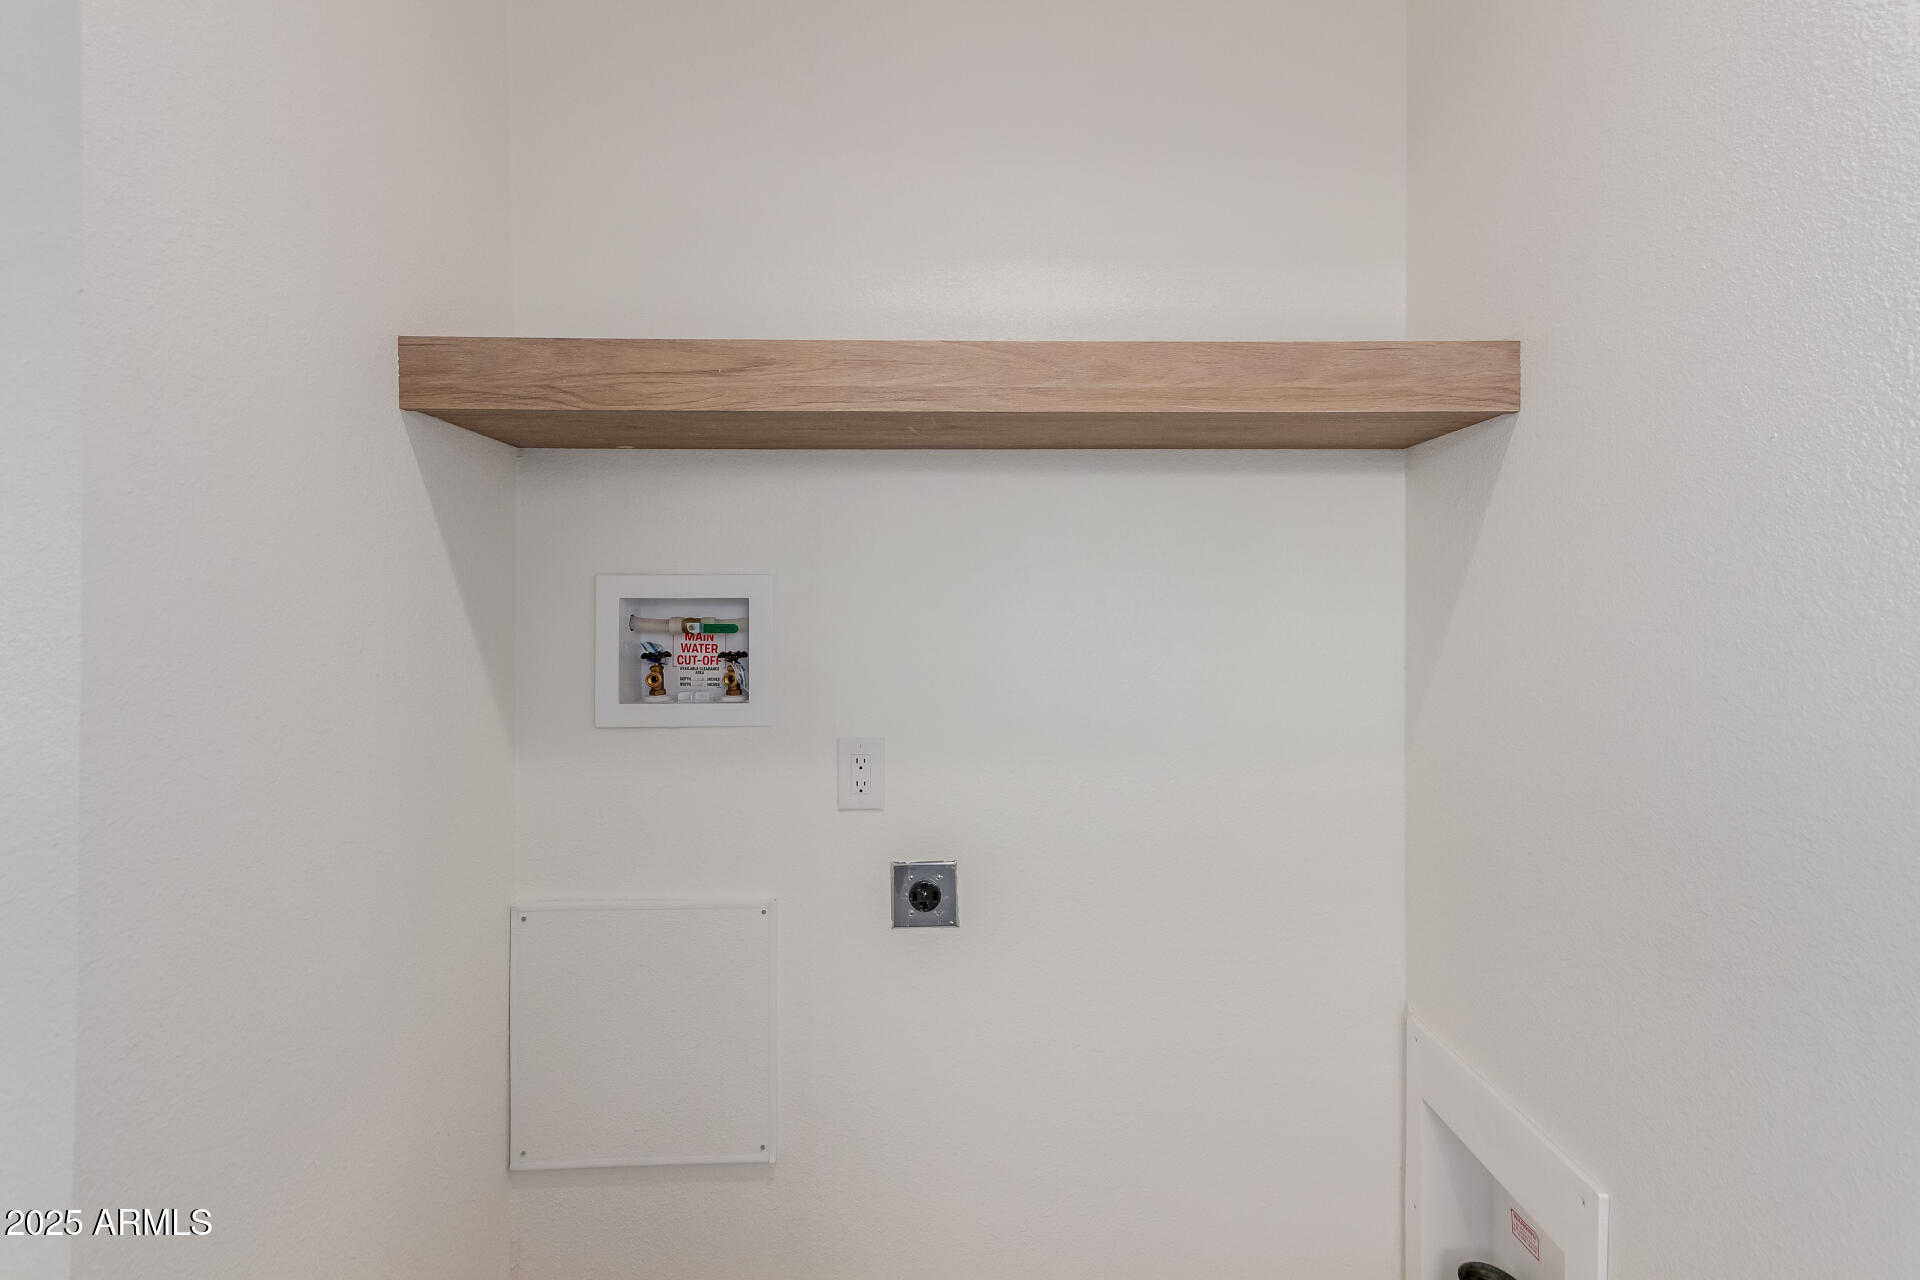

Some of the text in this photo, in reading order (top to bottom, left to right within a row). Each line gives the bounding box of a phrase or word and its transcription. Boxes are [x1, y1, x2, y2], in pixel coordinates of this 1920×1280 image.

[685, 632, 714, 641] MAIN
[680, 643, 718, 653] WATER
[677, 655, 721, 665] CUT-OFF
